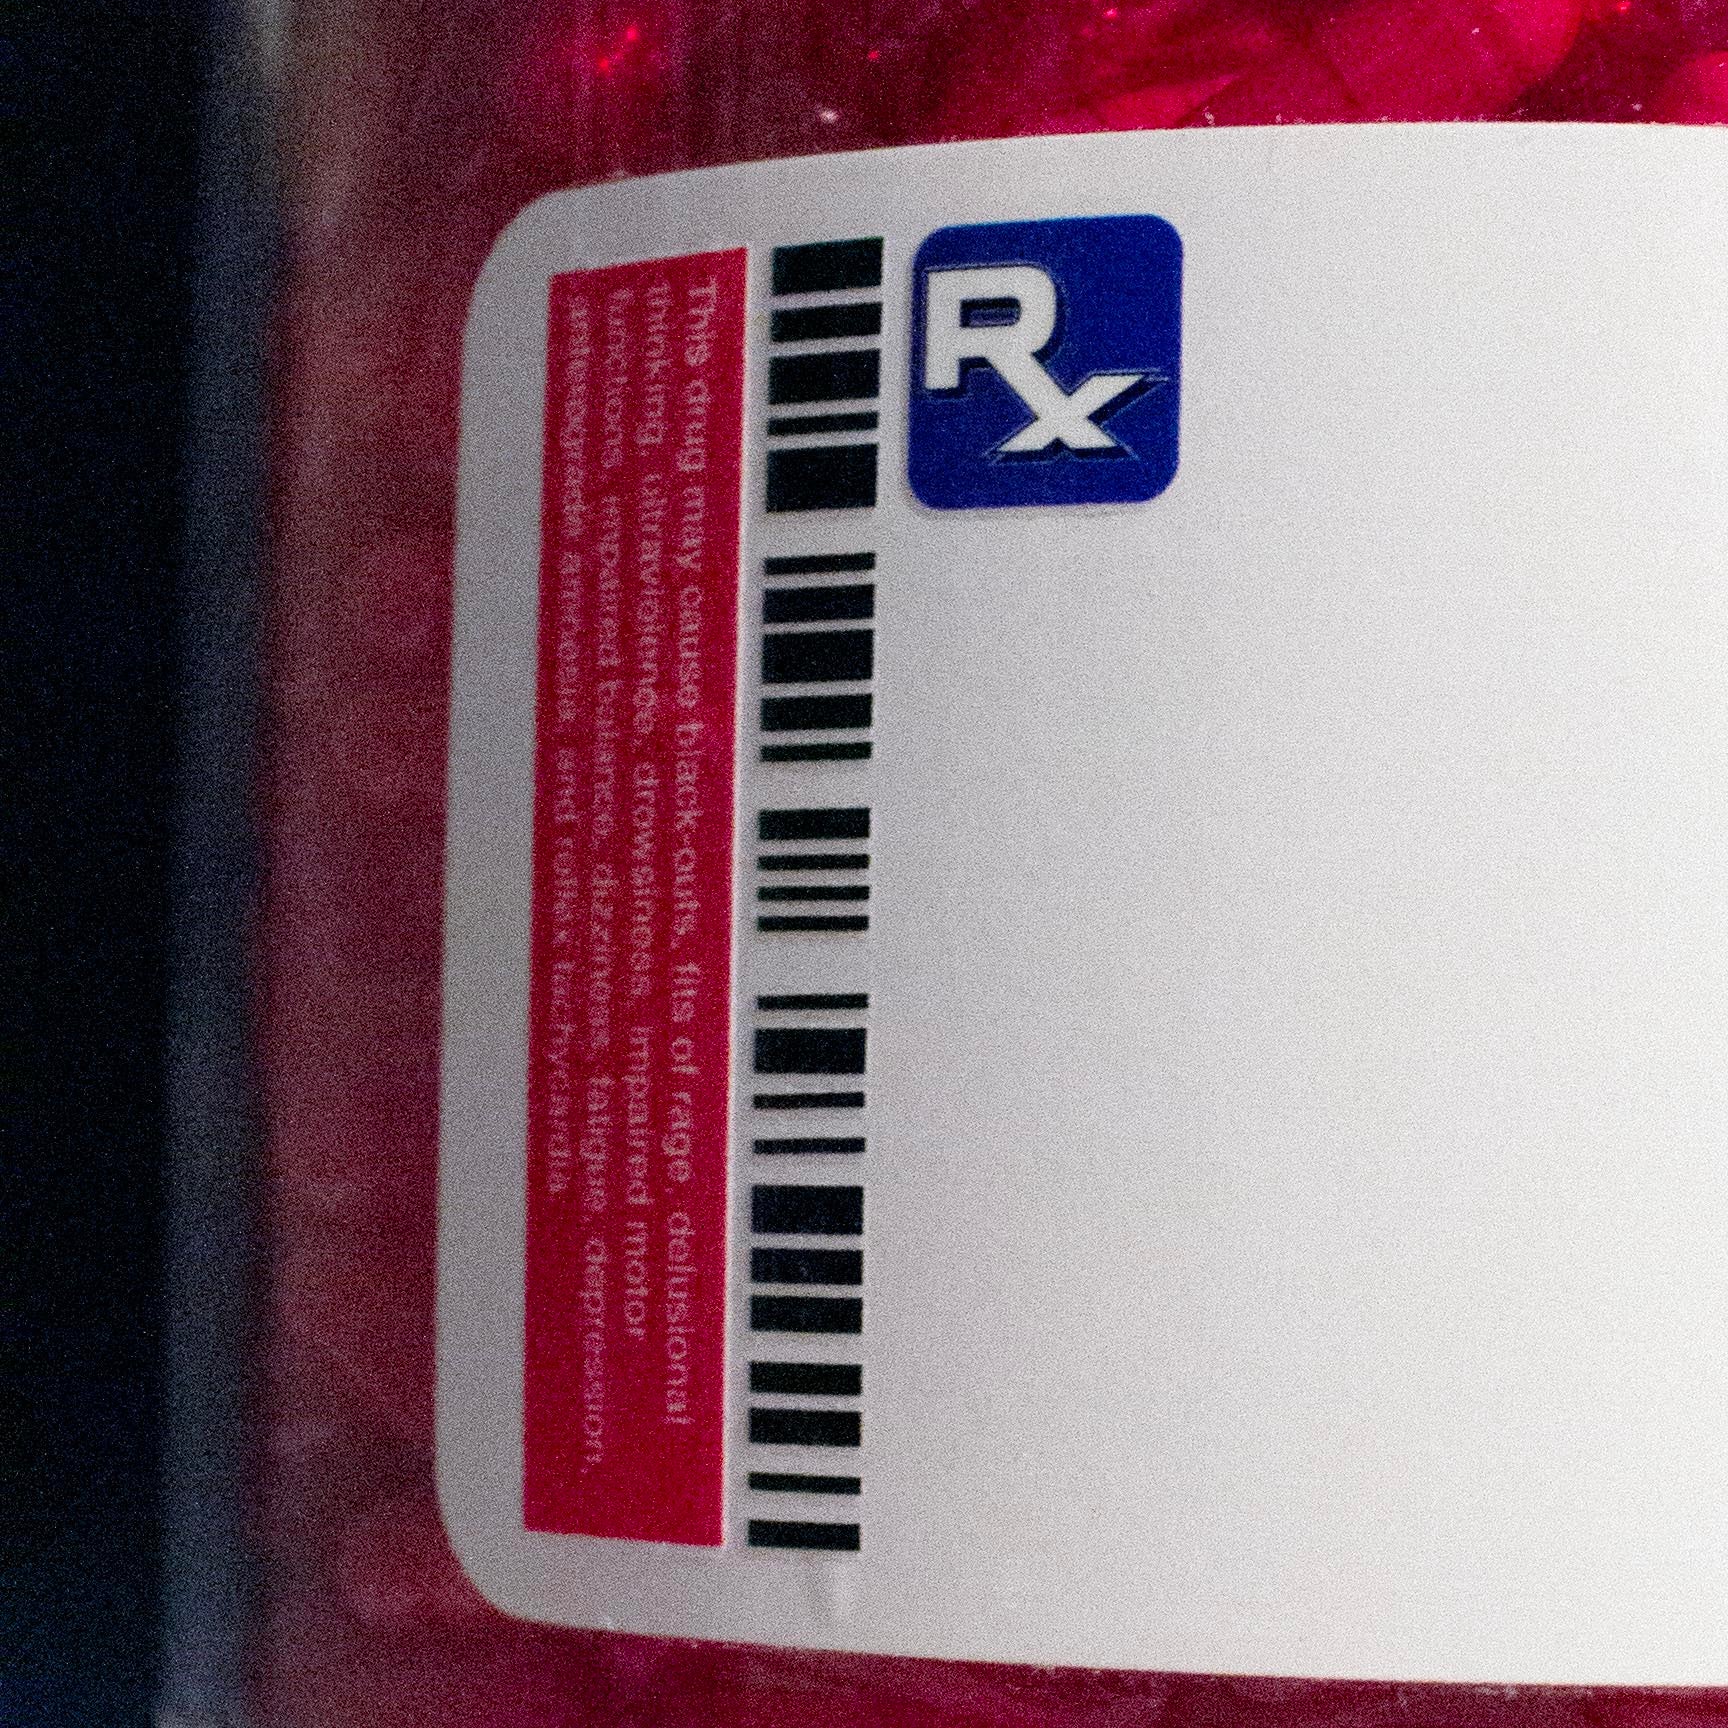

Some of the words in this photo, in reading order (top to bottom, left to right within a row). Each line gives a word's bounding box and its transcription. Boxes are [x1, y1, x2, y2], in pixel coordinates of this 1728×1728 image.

[634, 282, 672, 457] thinking,
[682, 277, 717, 367] This
[675, 379, 711, 473] drug
[674, 486, 705, 572] may
[592, 495, 622, 668] impaired
[674, 585, 703, 708] cause
[553, 748, 577, 824] and
[670, 962, 701, 1023] fits
[669, 1036, 700, 1076] of
[622, 1026, 653, 1205] impaired
[661, 1091, 695, 1194] rage,
[623, 1221, 648, 1341] motor
[664, 1211, 697, 1426] delusional
